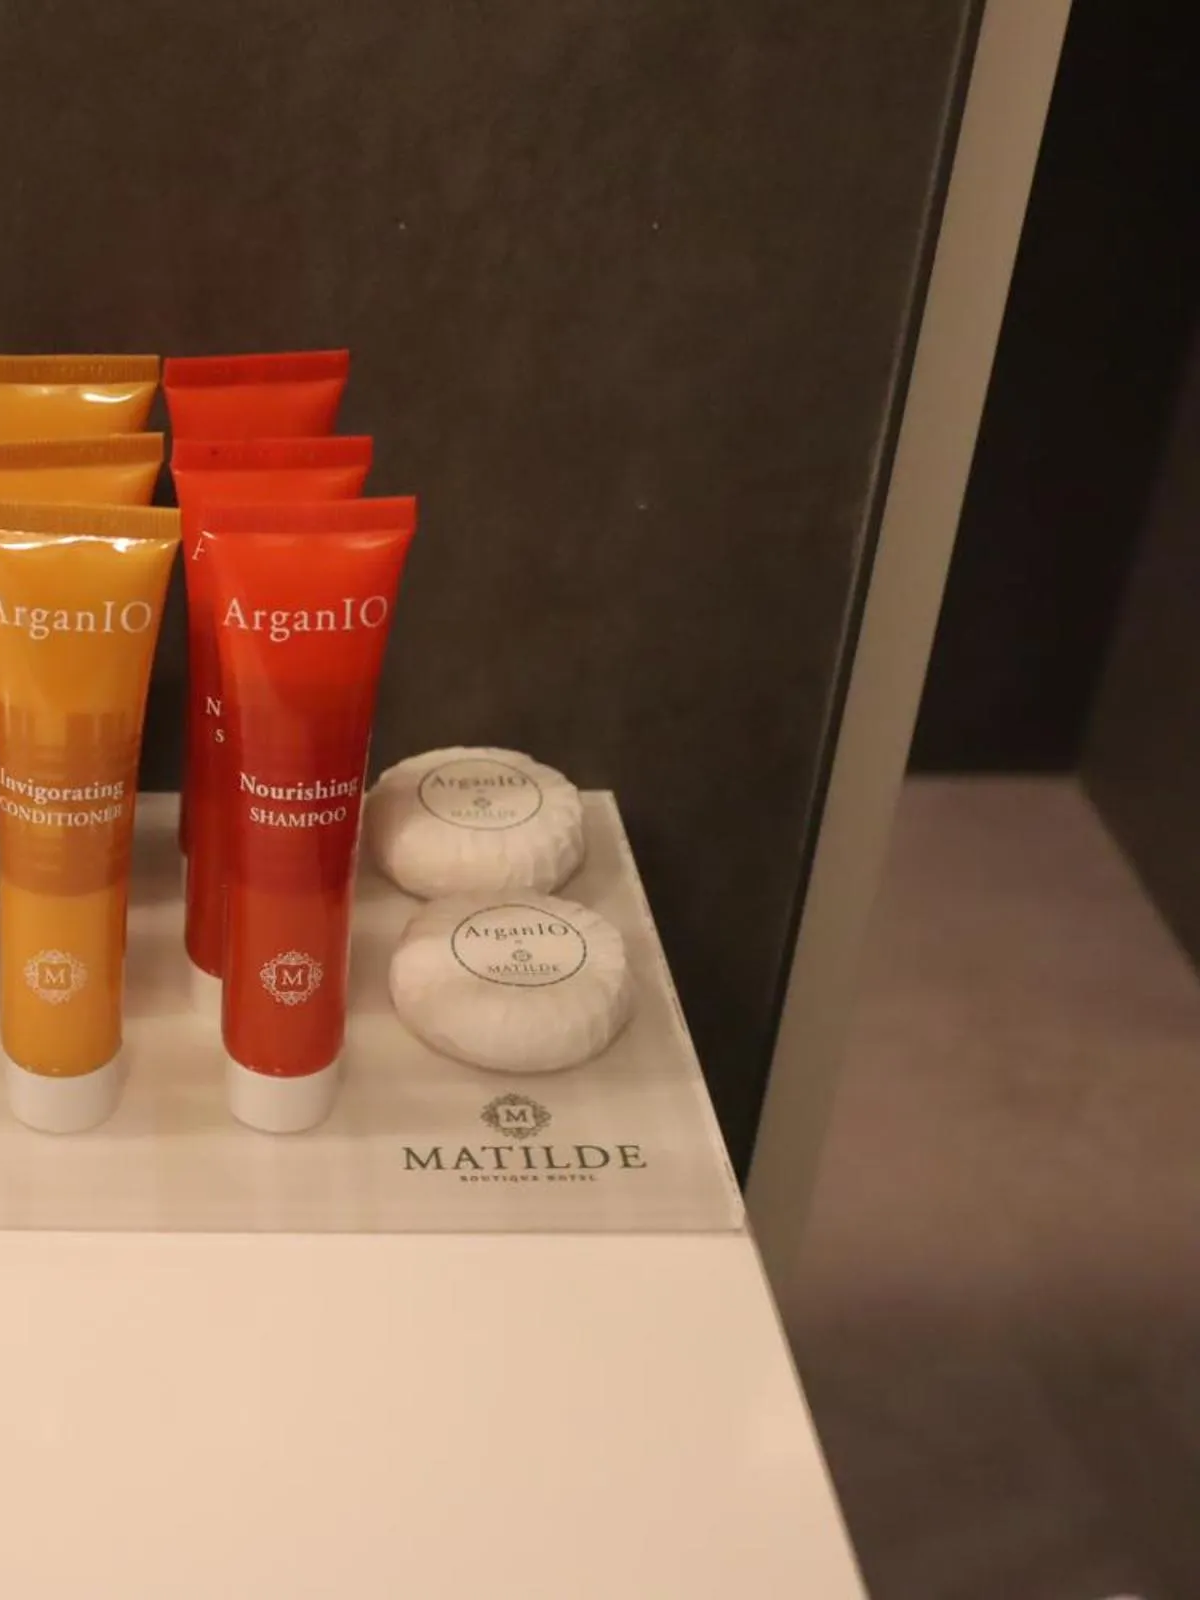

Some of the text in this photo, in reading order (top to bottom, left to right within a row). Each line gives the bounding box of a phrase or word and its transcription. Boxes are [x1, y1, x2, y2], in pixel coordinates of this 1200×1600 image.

[223, 595, 389, 642] ArganIO
[0, 766, 125, 806] Invigorating
[240, 770, 359, 800] Nourishing
[249, 806, 347, 828] SHAMPOO
[401, 1143, 648, 1171] MATILDE
